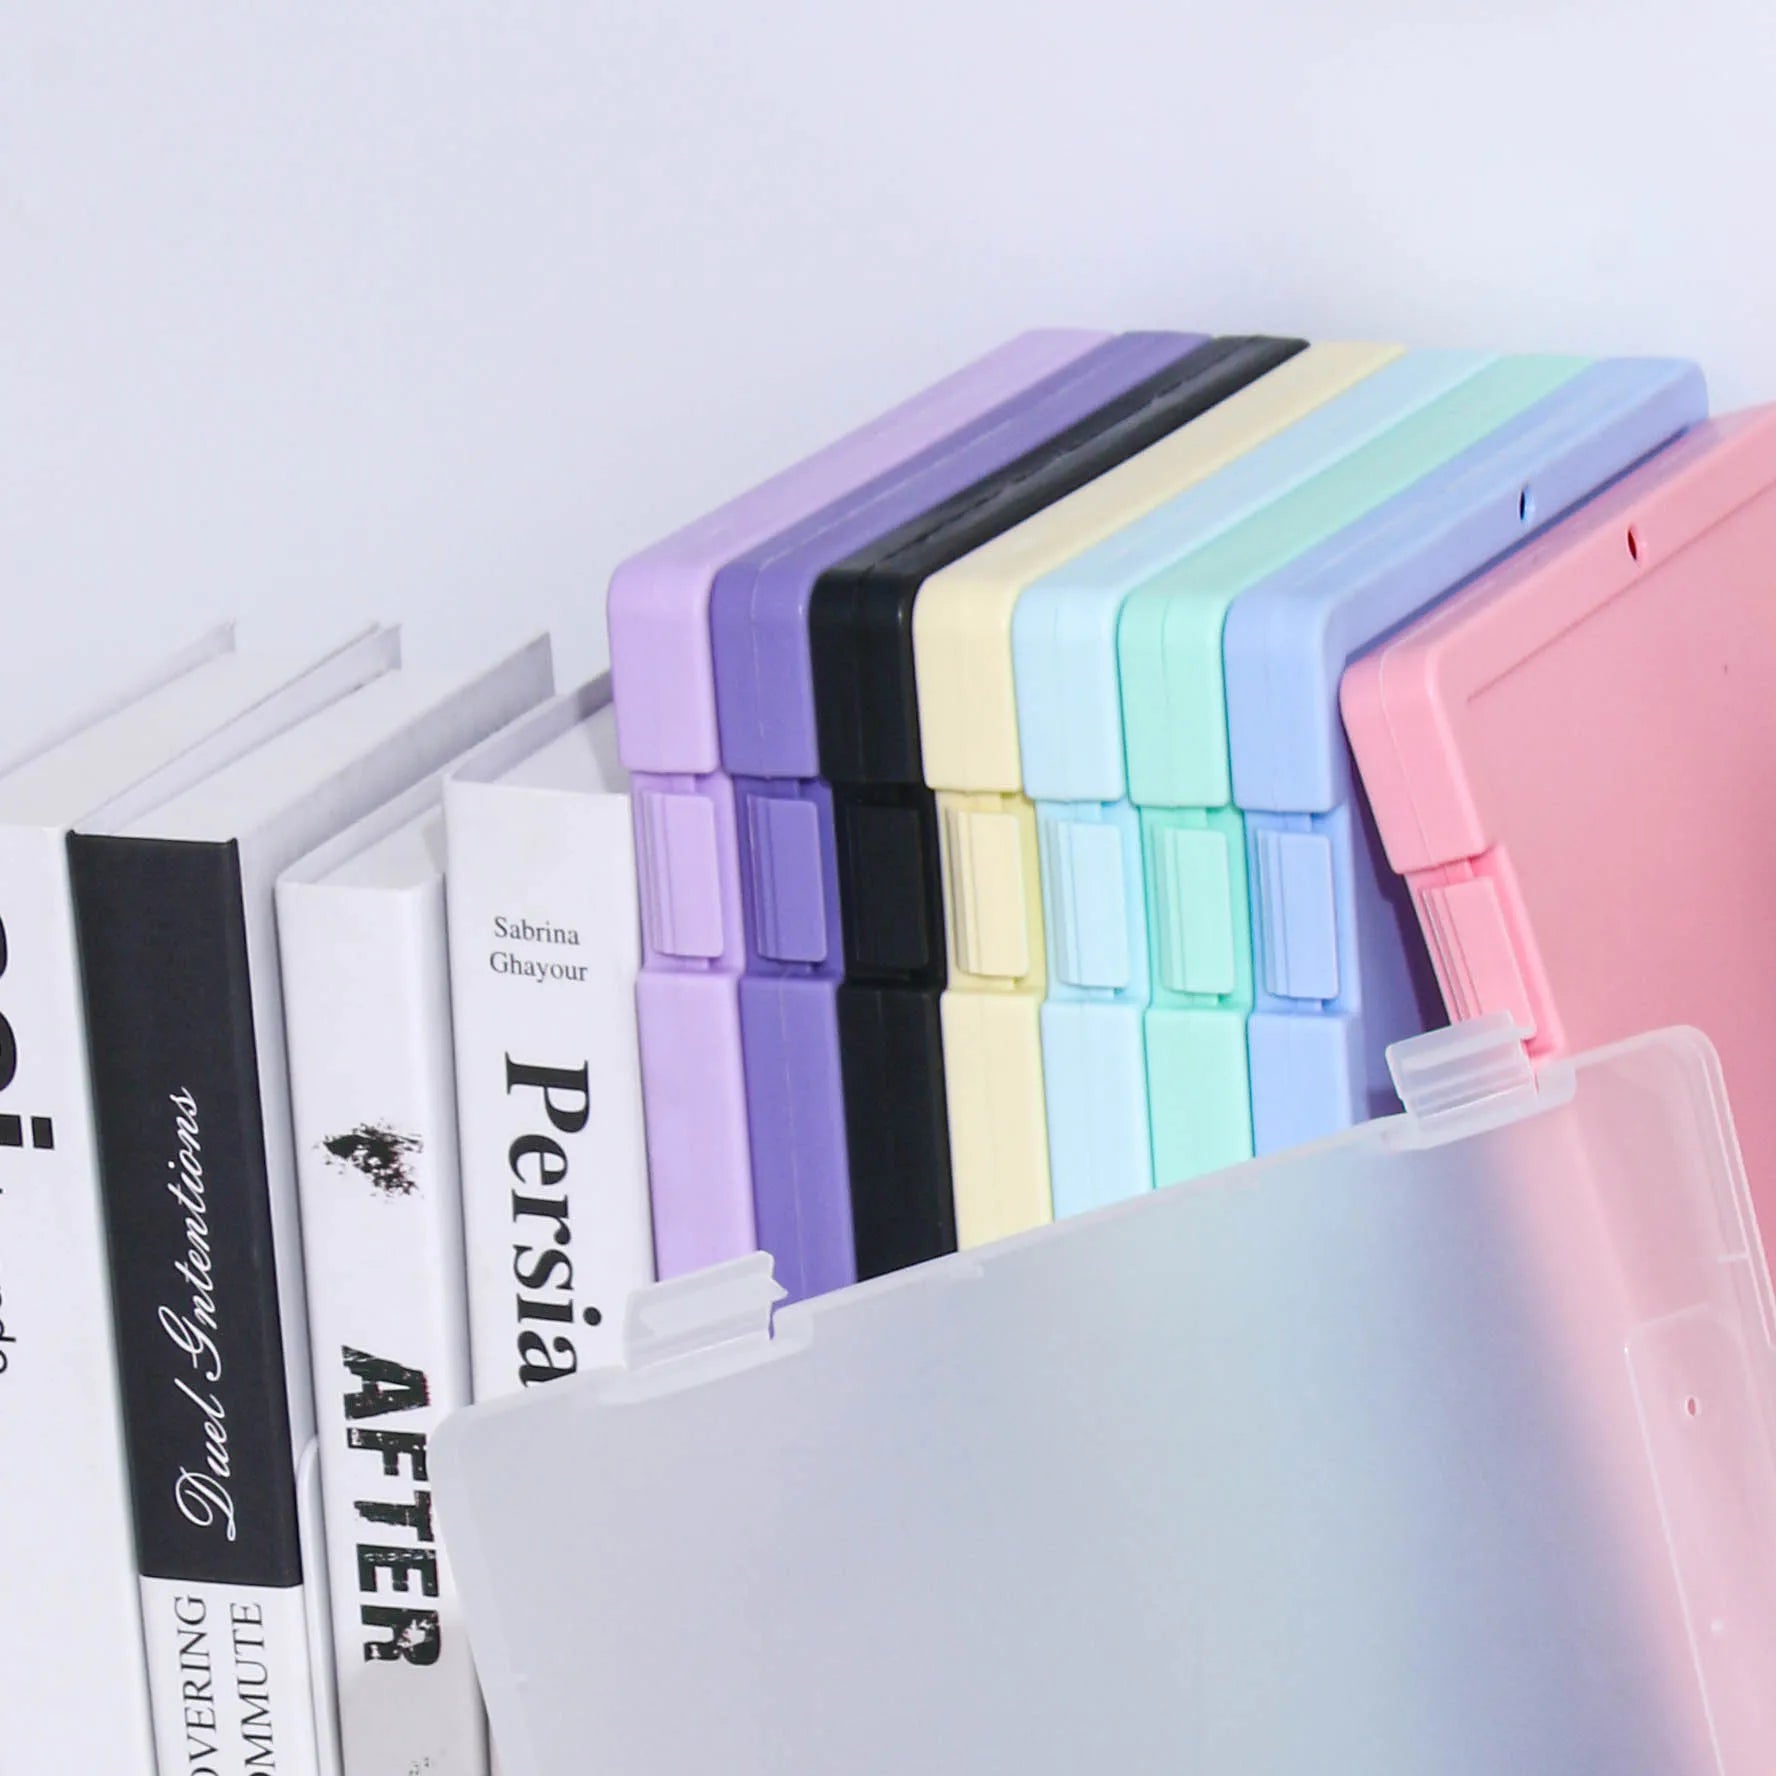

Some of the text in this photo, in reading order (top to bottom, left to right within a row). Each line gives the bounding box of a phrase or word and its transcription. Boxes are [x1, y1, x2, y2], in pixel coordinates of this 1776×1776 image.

[490, 952, 588, 983] Ghayour
[494, 916, 580, 945] Sabrina
[175, 1373, 235, 1541] Duel
[342, 1346, 441, 1666] AFTER
